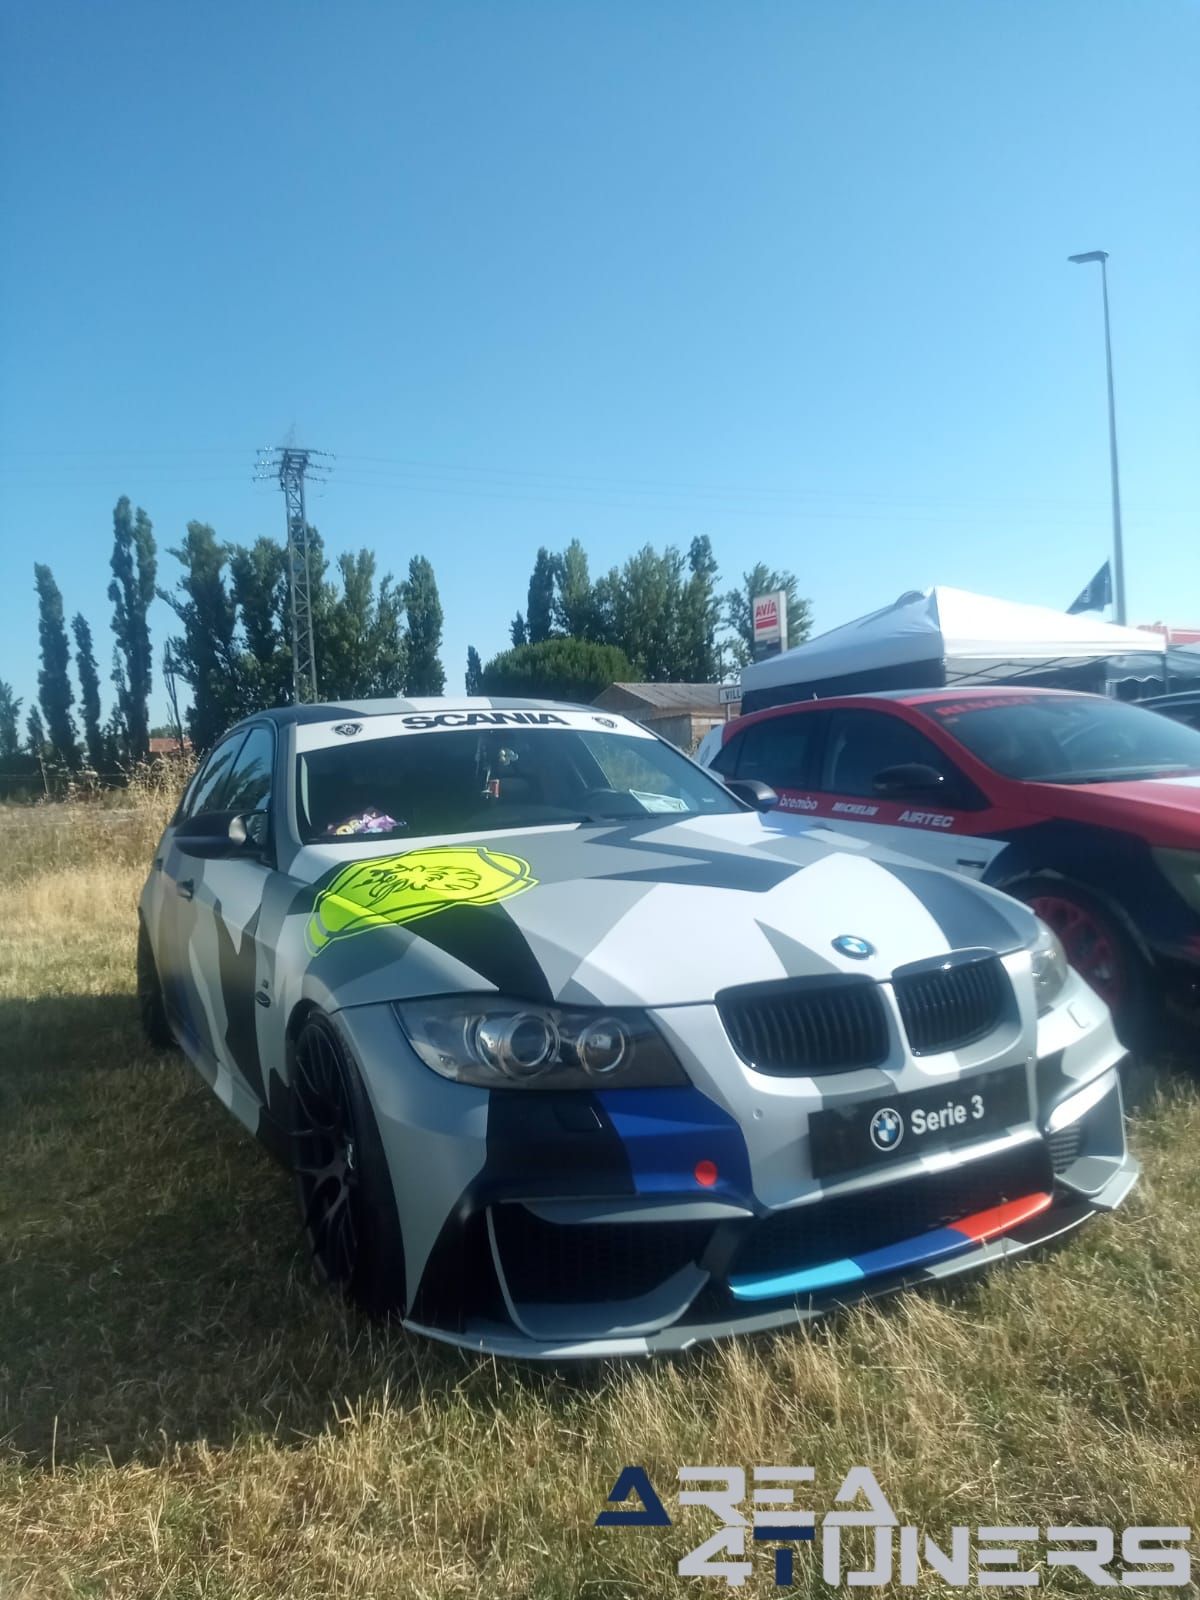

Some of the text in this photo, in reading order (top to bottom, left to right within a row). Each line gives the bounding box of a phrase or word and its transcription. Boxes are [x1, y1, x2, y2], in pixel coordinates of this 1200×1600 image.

[402, 712, 572, 729] SCANIA
[779, 794, 818, 811] brembo
[832, 802, 879, 816] MICHELIN
[897, 810, 955, 828] AIRTEC
[911, 1094, 985, 1135] Serie 3
